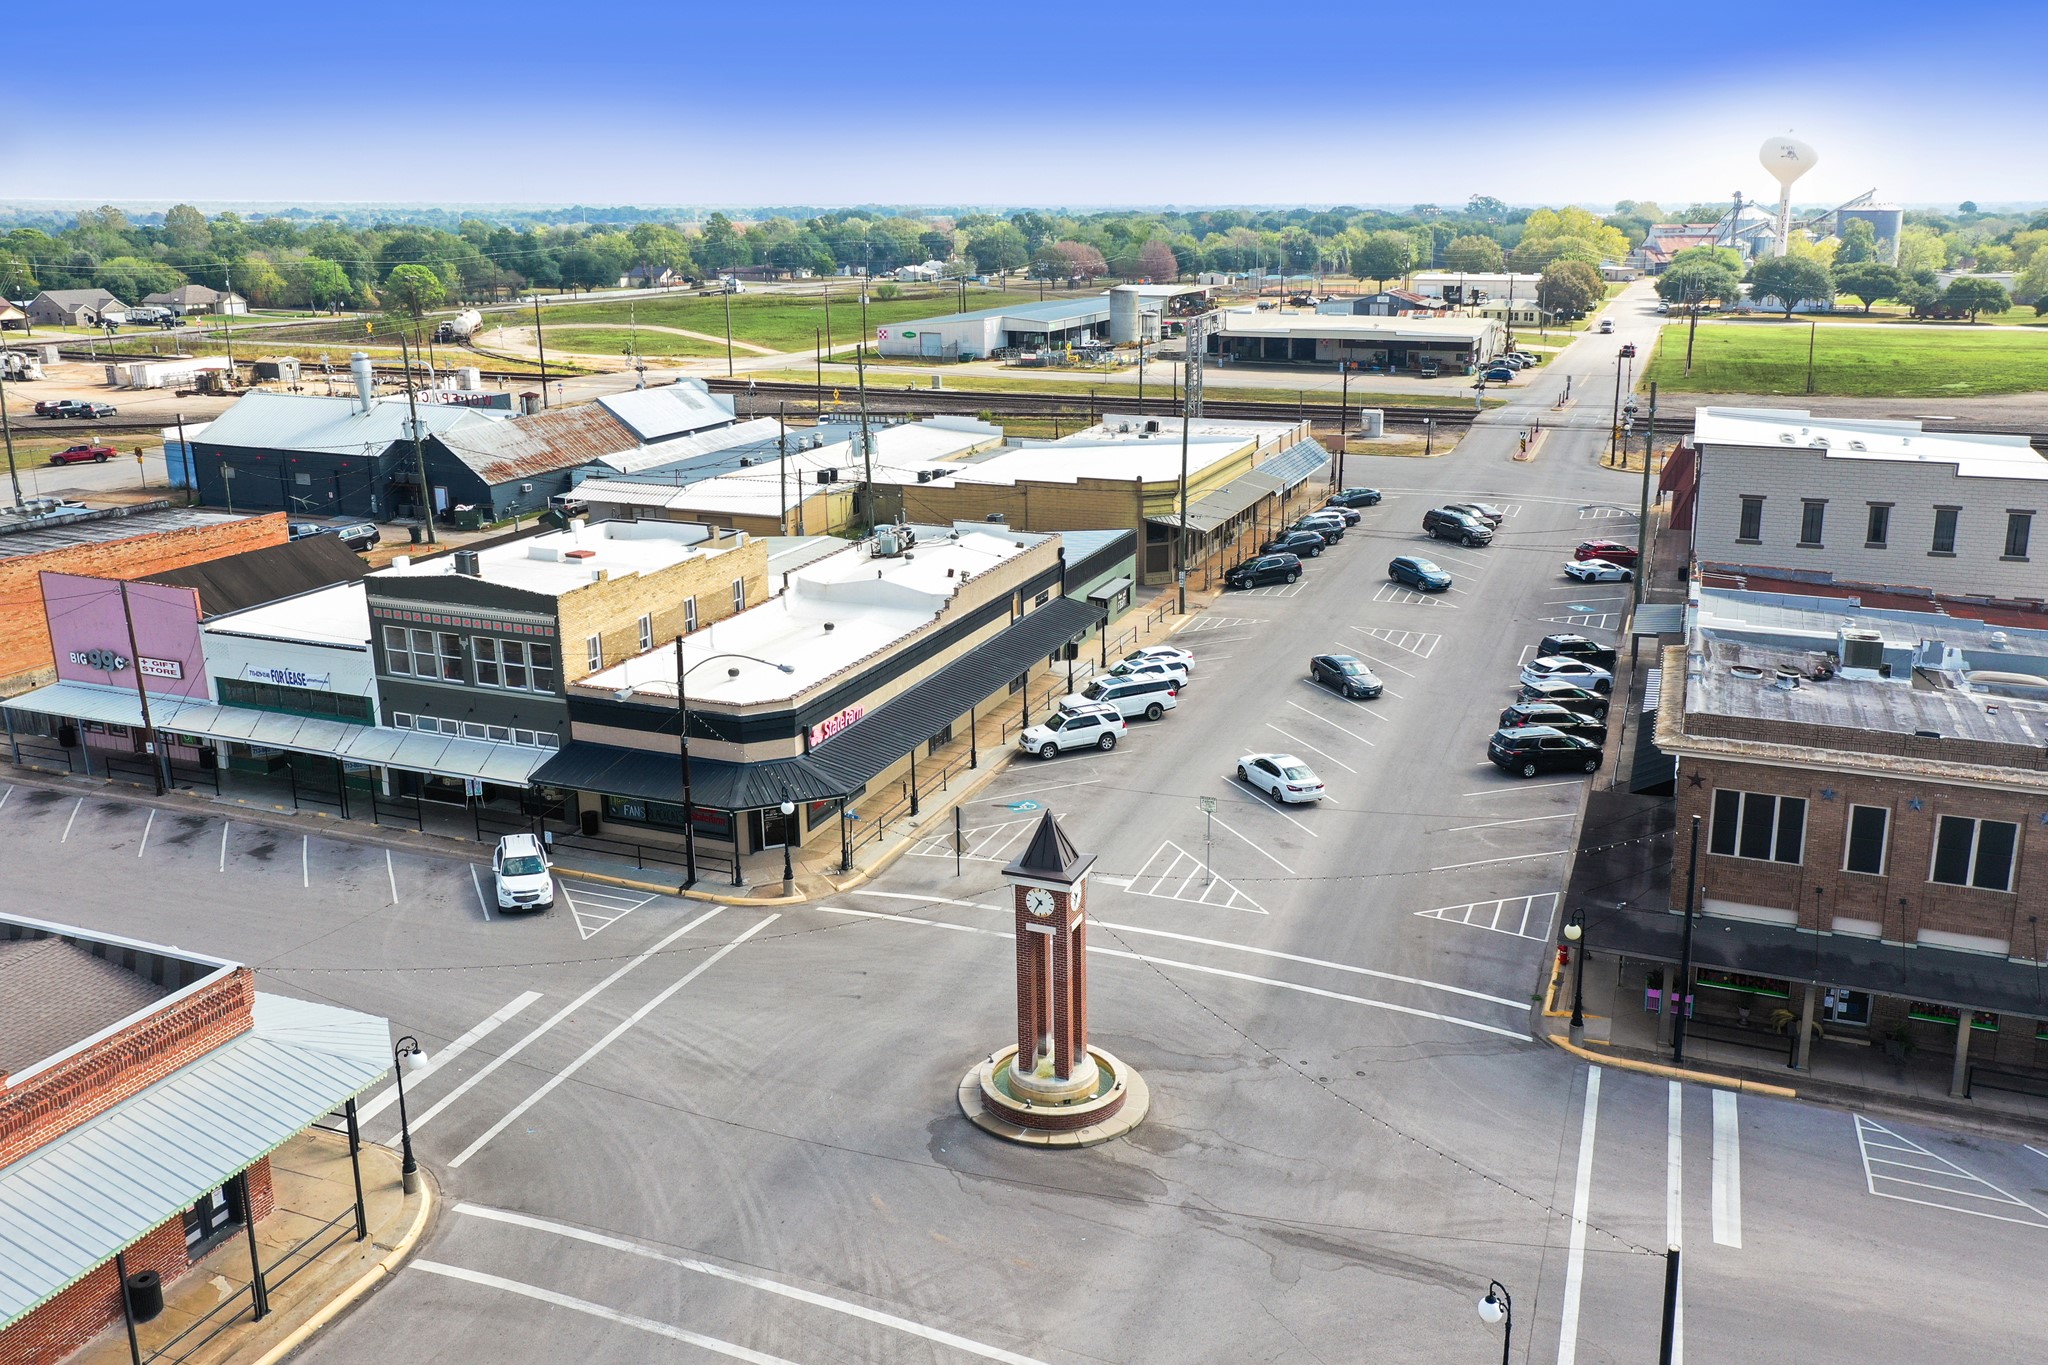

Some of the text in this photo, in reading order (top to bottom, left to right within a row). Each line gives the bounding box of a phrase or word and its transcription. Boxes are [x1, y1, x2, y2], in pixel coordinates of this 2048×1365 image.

[69, 652, 88, 665] BIG
[151, 660, 176, 669] GIFT
[141, 665, 178, 676] STORE
[270, 669, 286, 684] FOR
[284, 671, 307, 686] LEASE
[623, 804, 646, 819] FANS
